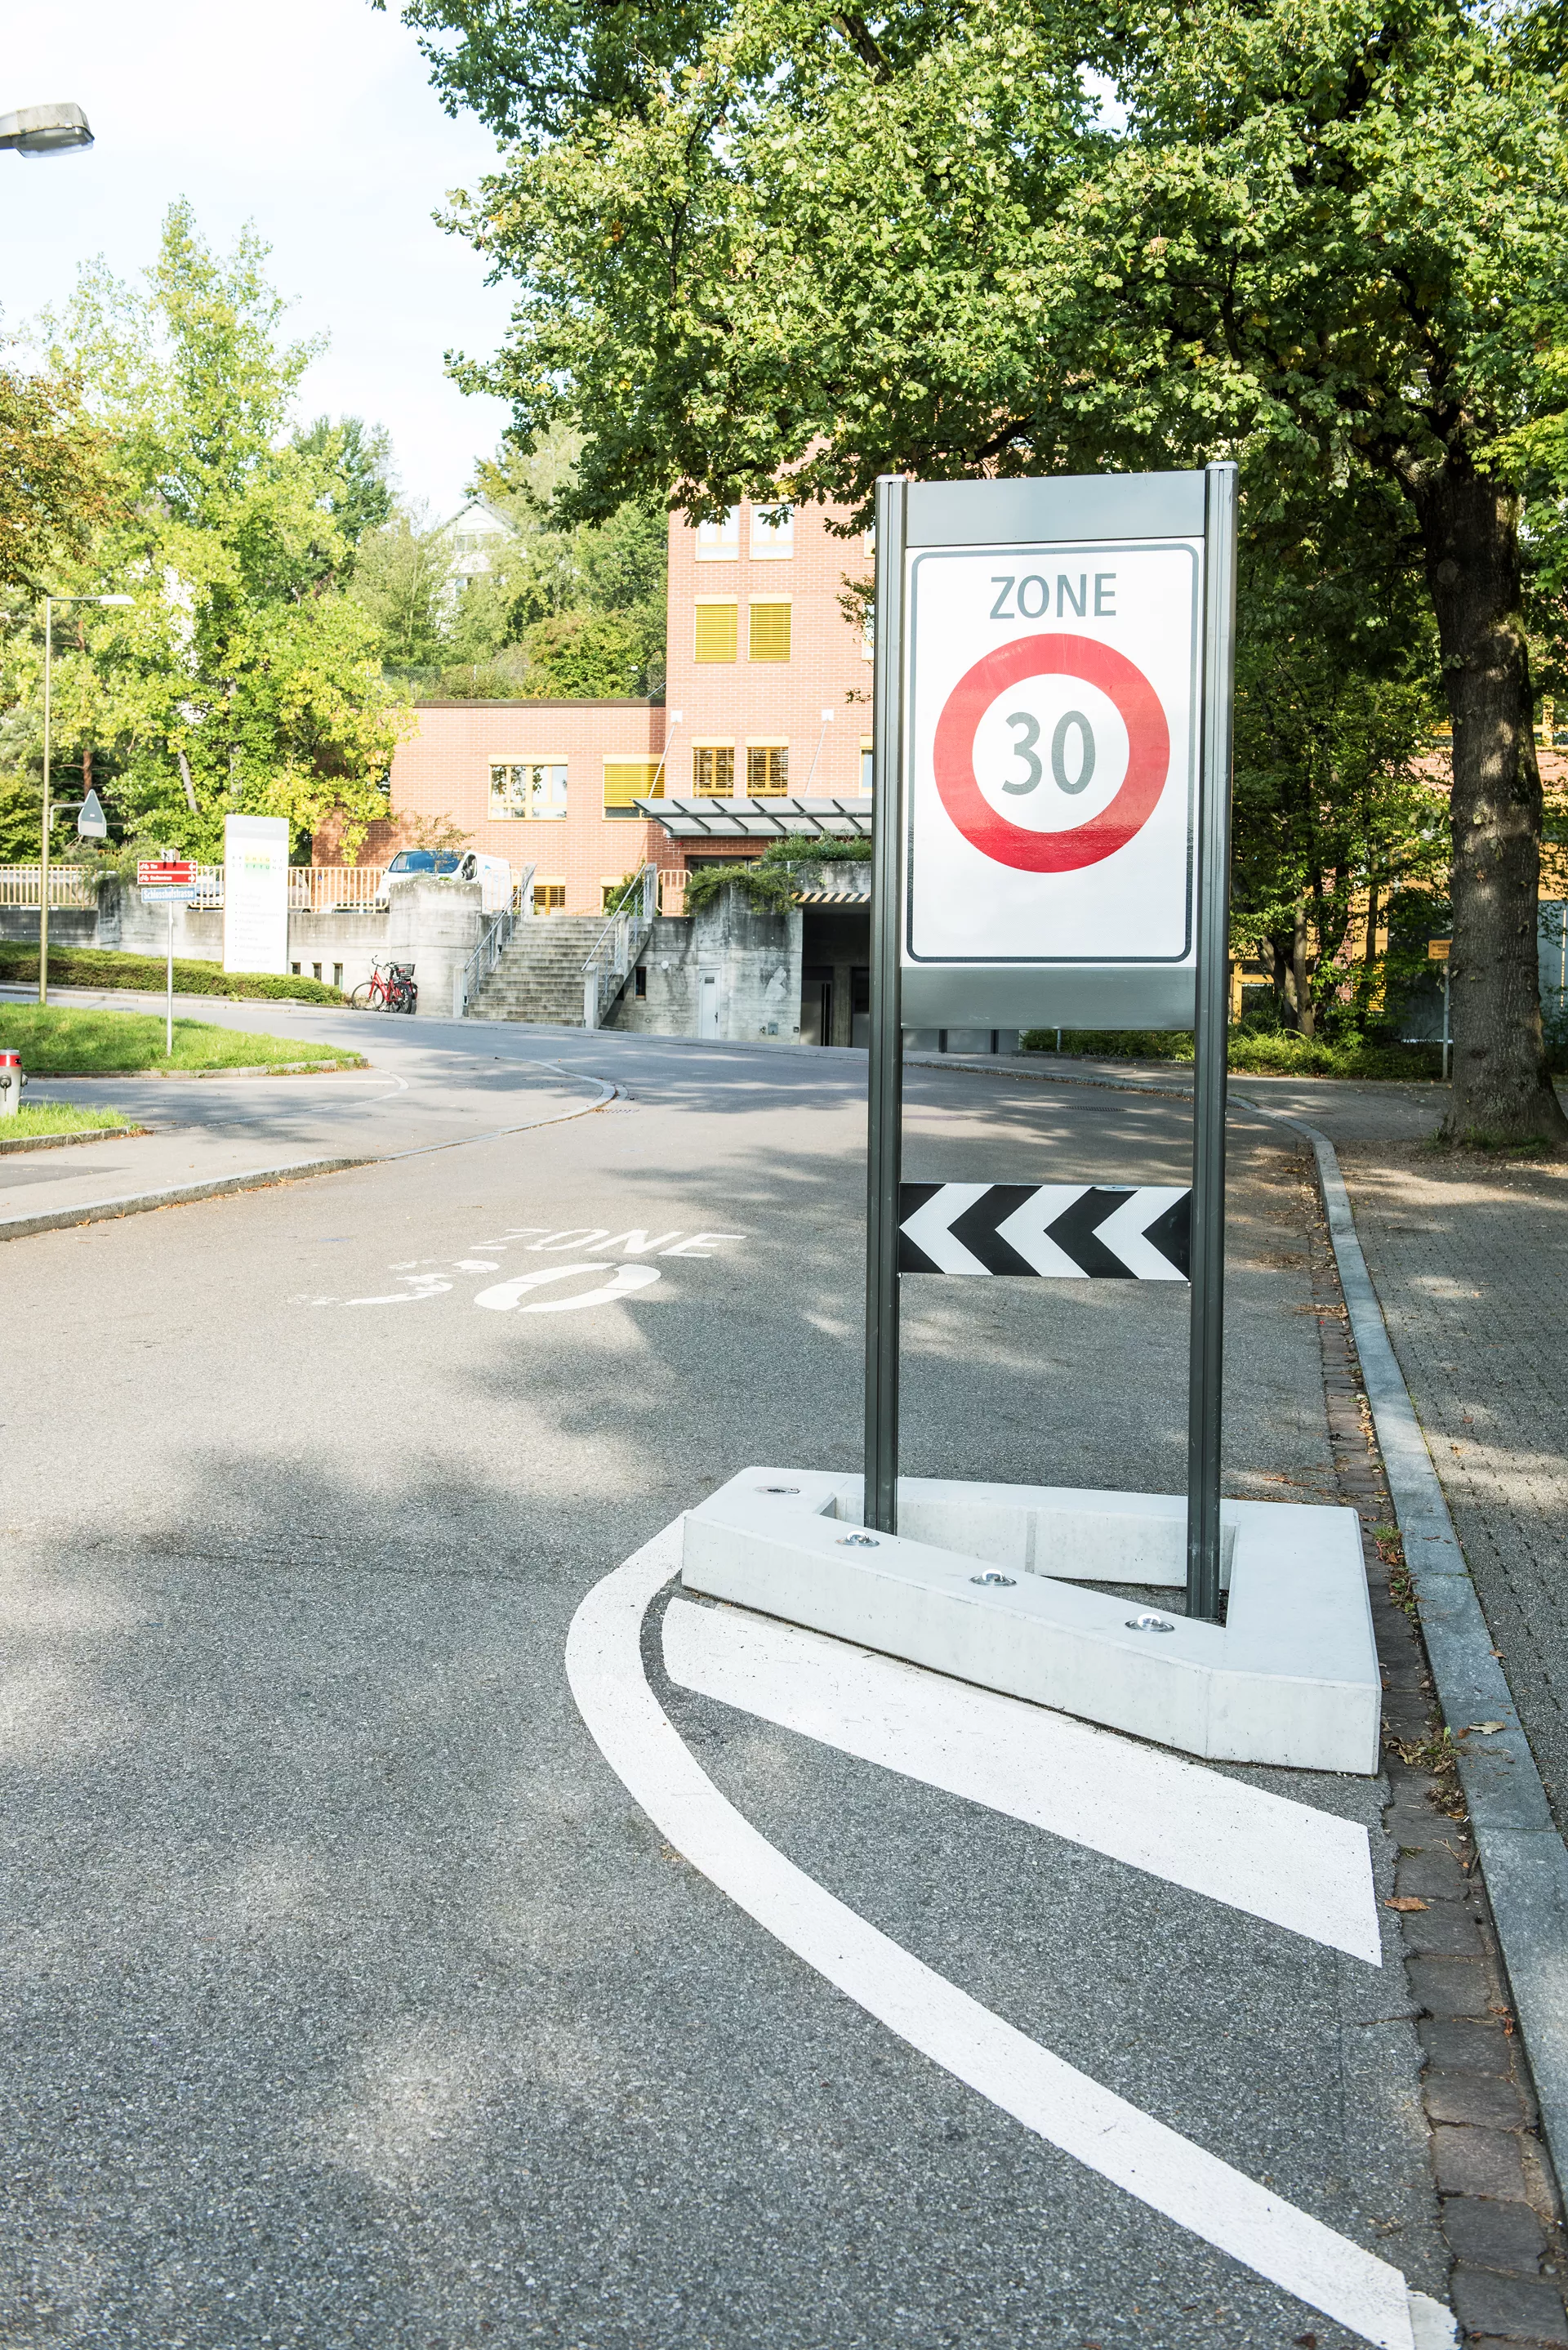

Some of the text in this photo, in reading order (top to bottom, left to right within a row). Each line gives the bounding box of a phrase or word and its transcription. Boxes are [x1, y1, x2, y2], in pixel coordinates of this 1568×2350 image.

[990, 573, 1116, 619] ZONE
[1001, 711, 1096, 795] 30
[144, 889, 194, 900] Schlosshofstrasse
[469, 1229, 746, 1258] ZONE
[283, 1259, 662, 1312] 30
